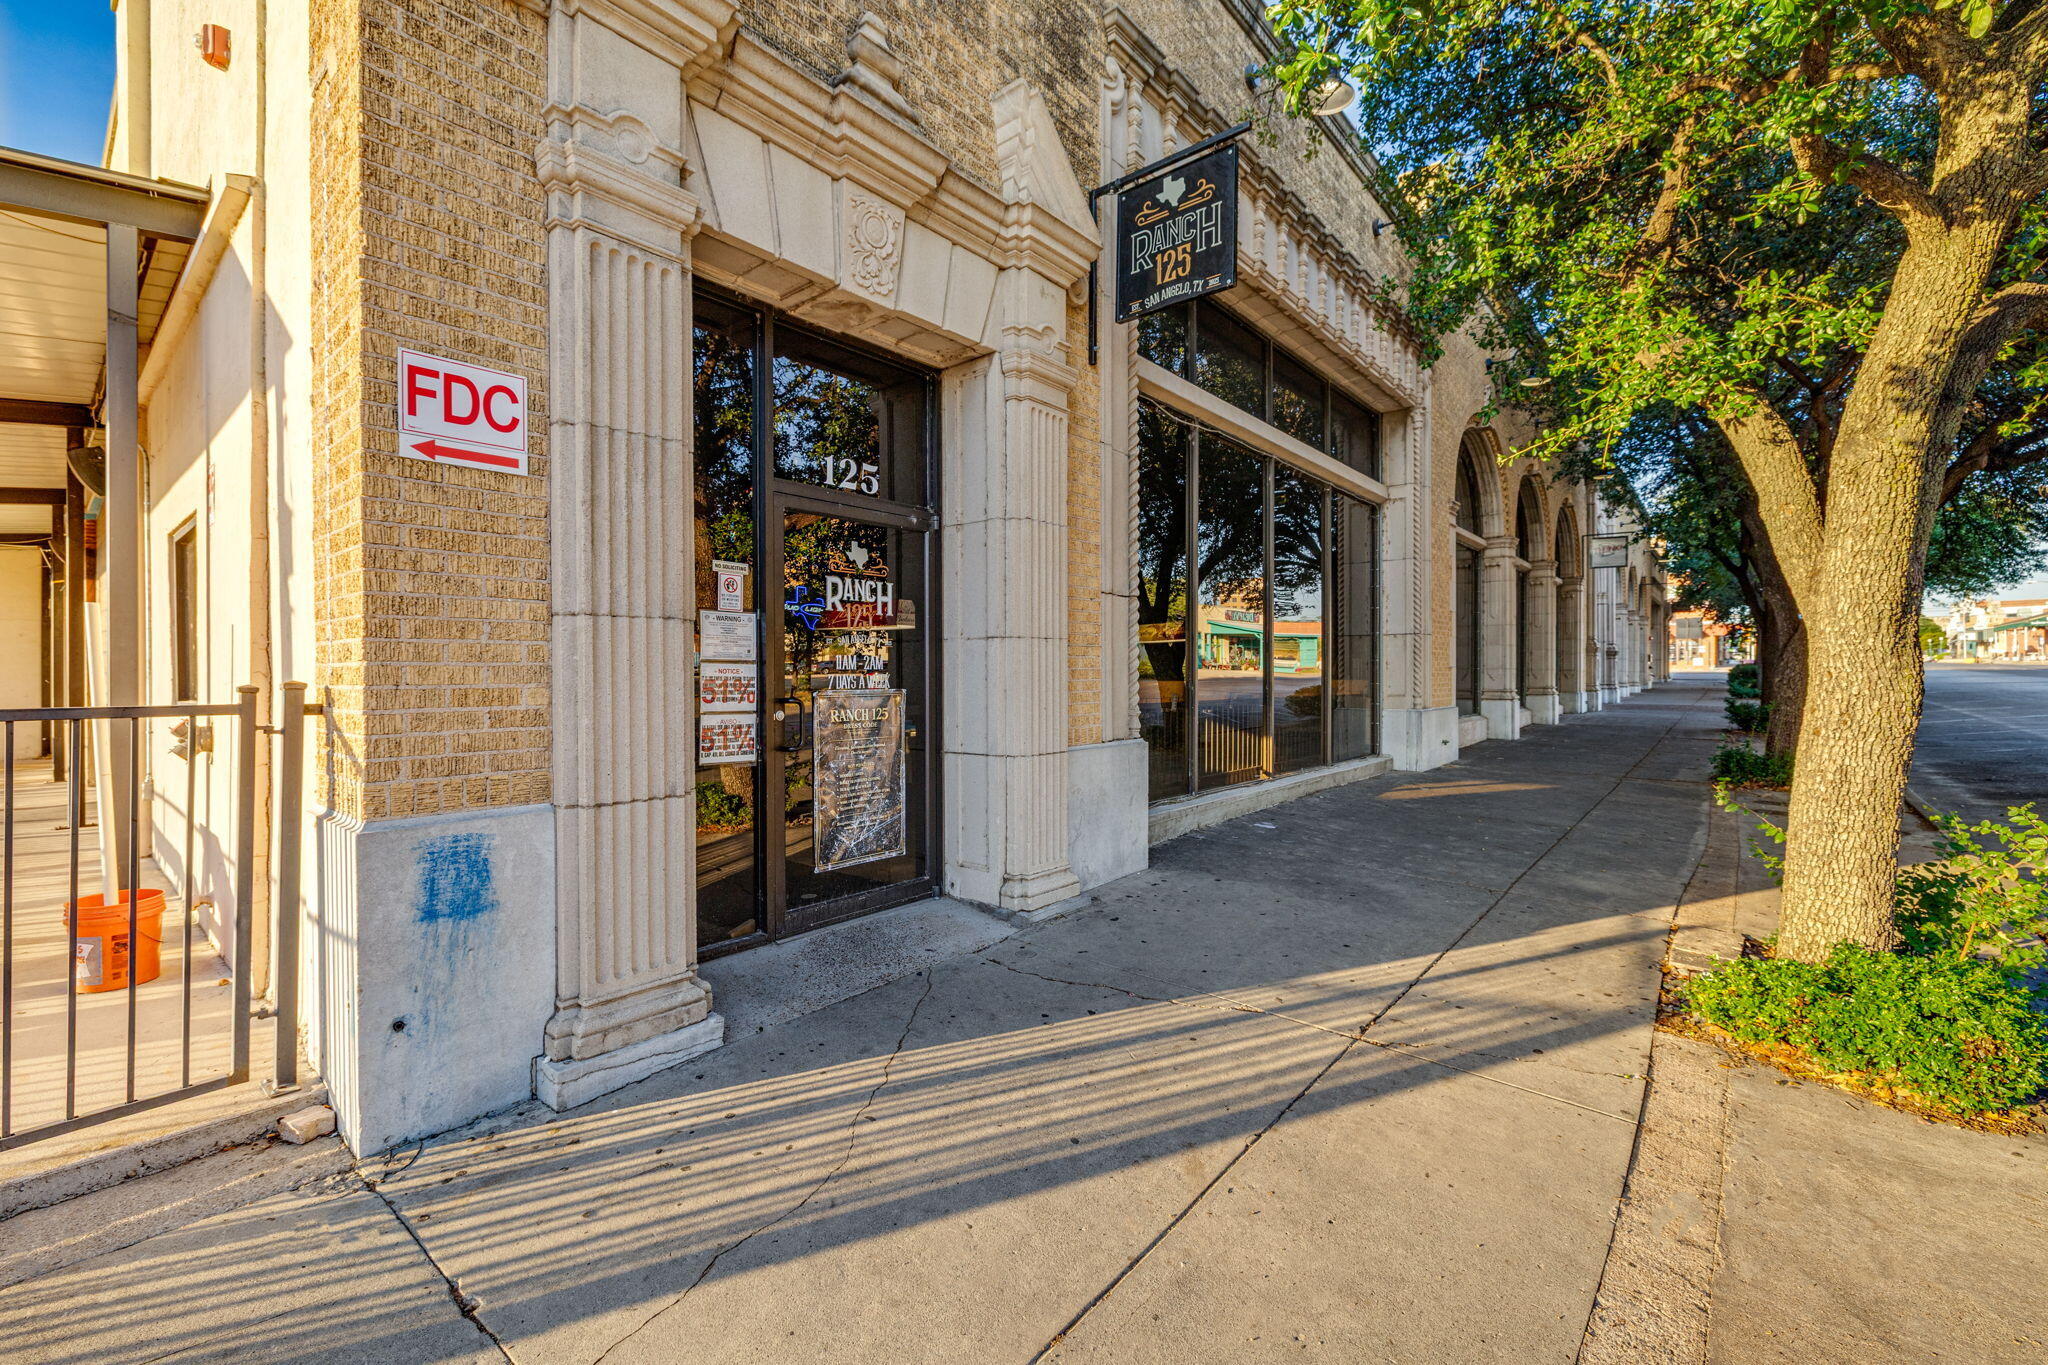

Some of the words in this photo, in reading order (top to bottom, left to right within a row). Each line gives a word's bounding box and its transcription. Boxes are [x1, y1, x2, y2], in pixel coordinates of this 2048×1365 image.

[1131, 200, 1223, 275] RANCH
[1155, 242, 1192, 286] 125
[1144, 292, 1160, 309] SAN
[1161, 281, 1192, 301] ANGELO,
[1193, 279, 1205, 292] TX
[407, 364, 520, 433] FDC
[823, 455, 879, 495] 125
[722, 564, 747, 572] SOLICITING
[825, 575, 894, 617] RANCH
[715, 615, 742, 623] WARNING
[835, 654, 857, 671] 11AM
[863, 655, 884, 670] 2AM
[702, 679, 755, 704] 51%
[828, 674, 834, 689] 7
[836, 674, 857, 689] DAYS
[858, 673, 865, 689] A
[830, 708, 869, 723] RANCH
[872, 707, 889, 720] 125
[702, 727, 755, 752] 51%
